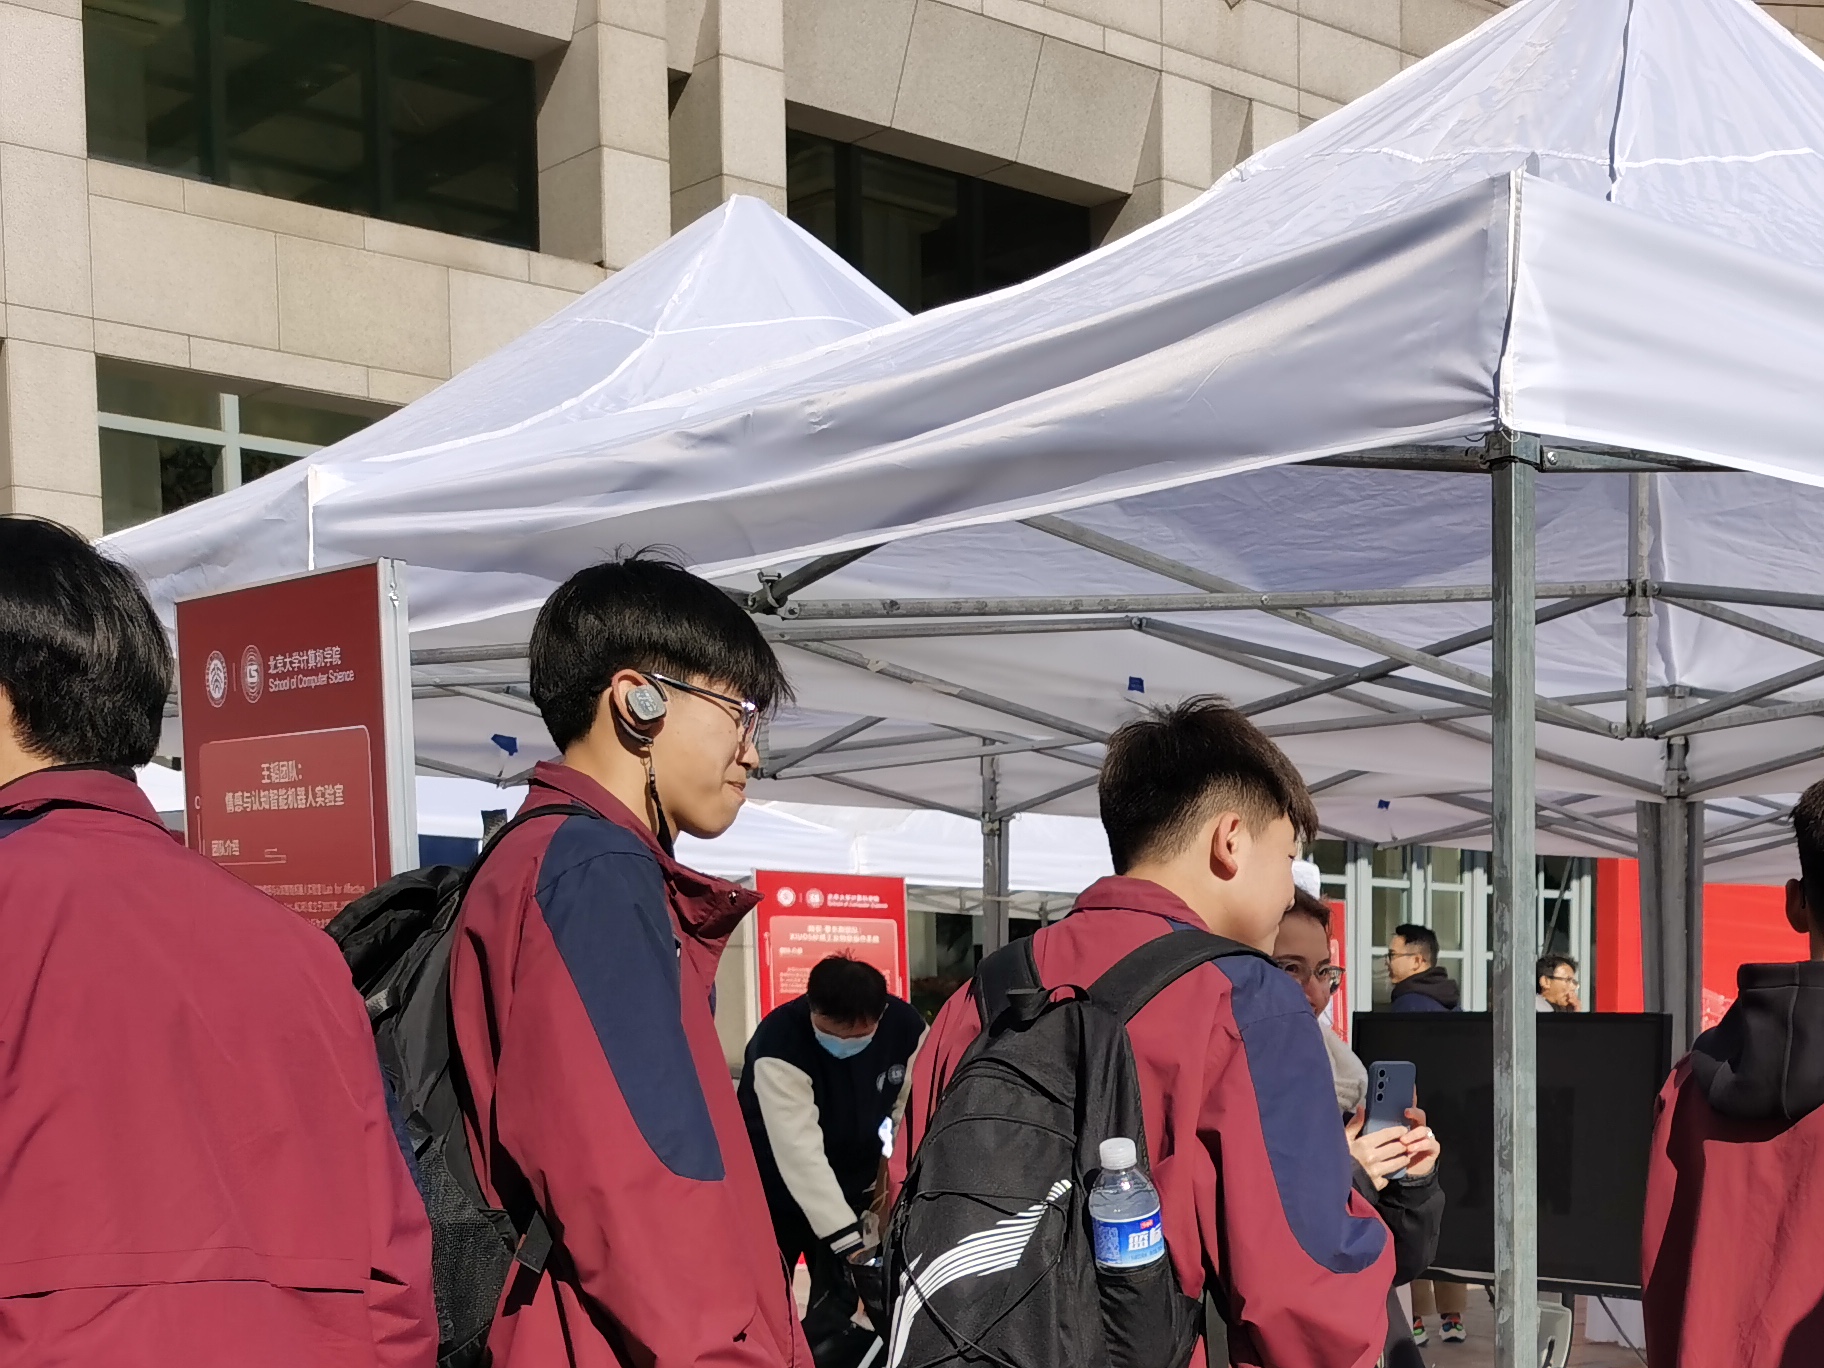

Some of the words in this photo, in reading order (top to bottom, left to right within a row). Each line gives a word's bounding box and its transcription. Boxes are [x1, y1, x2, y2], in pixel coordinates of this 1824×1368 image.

[267, 645, 342, 674] 北京大学计算机学院
[268, 677, 290, 692] School
[291, 677, 297, 689] of
[298, 673, 328, 689] Computer
[328, 668, 355, 684] Science
[225, 783, 345, 813] 情感与认知智能机器人实验室
